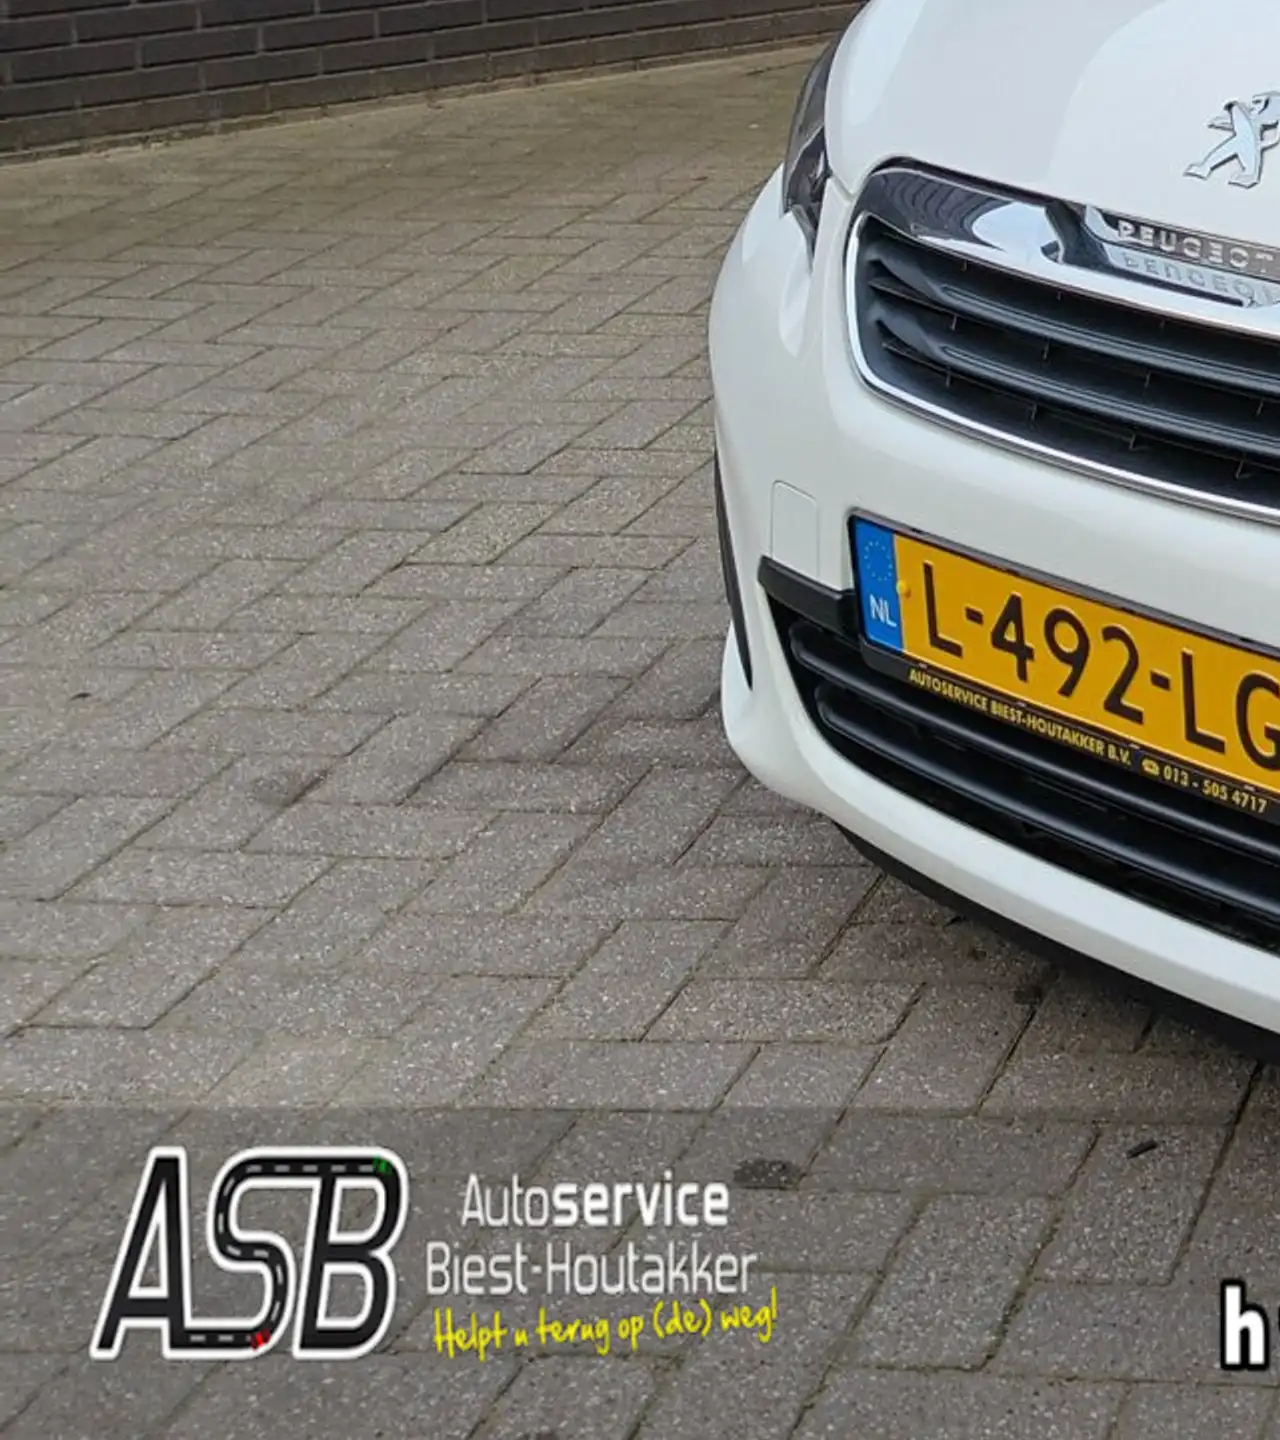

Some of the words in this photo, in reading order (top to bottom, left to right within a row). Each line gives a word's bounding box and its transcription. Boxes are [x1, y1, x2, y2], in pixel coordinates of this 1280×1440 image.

[1117, 219, 1274, 273] PEUGEOT
[869, 593, 897, 628] NL
[909, 668, 988, 710] AUTOSERVICE
[990, 700, 1104, 757] BIEST-HOUTAKKER
[1107, 744, 1132, 765] B.V.
[1163, 767, 1190, 788] 013
[1202, 779, 1228, 801] 505
[1232, 789, 1268, 813] 4717
